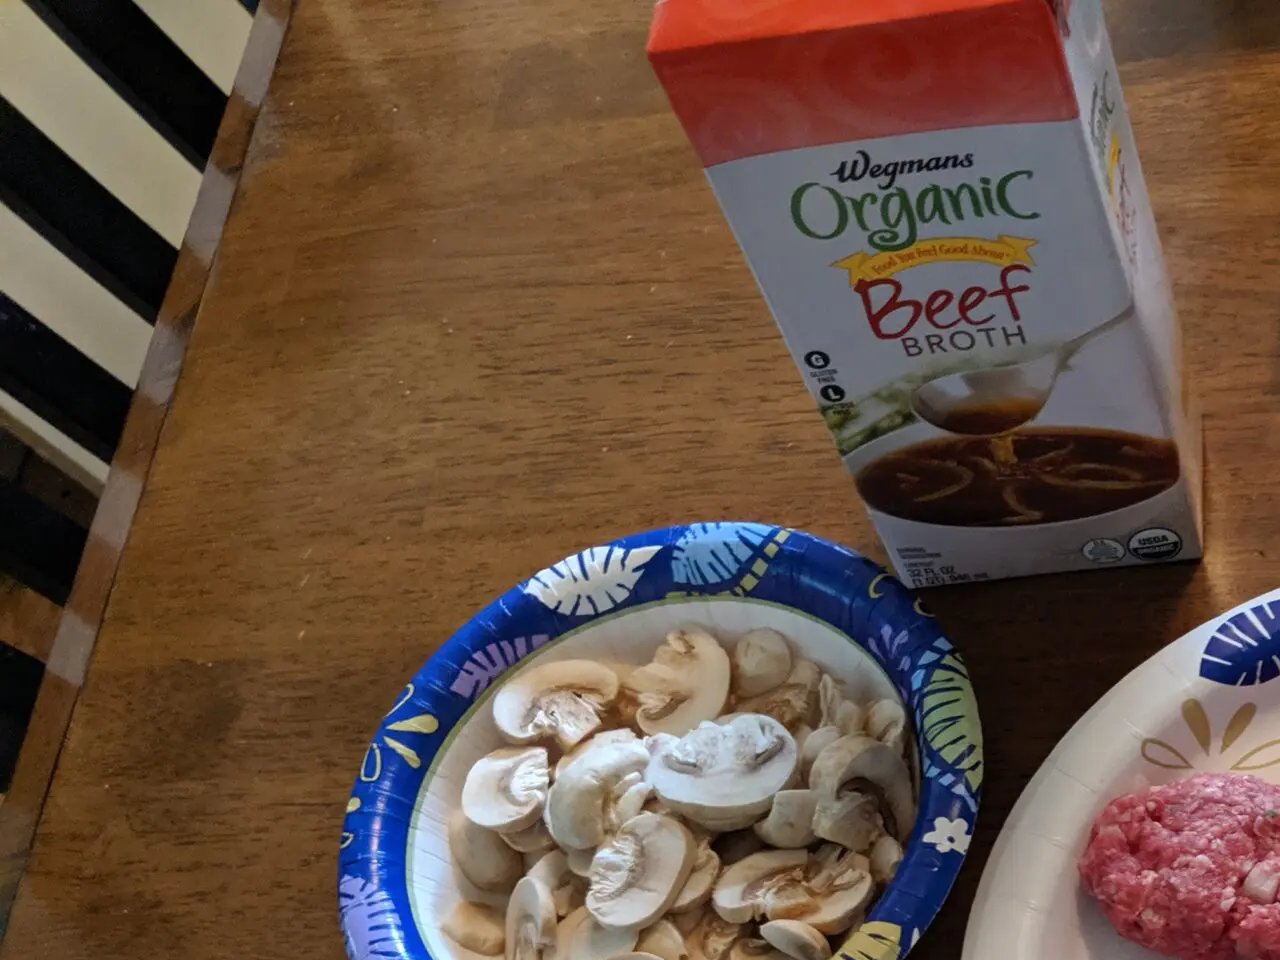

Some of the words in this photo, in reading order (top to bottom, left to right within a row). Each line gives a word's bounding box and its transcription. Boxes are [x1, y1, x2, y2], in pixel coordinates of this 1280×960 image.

[830, 150, 974, 190] Wegmans
[789, 170, 1041, 252] Organic
[939, 243, 969, 255] Good
[854, 264, 1032, 340] Beef
[901, 325, 1028, 357] BROTH
